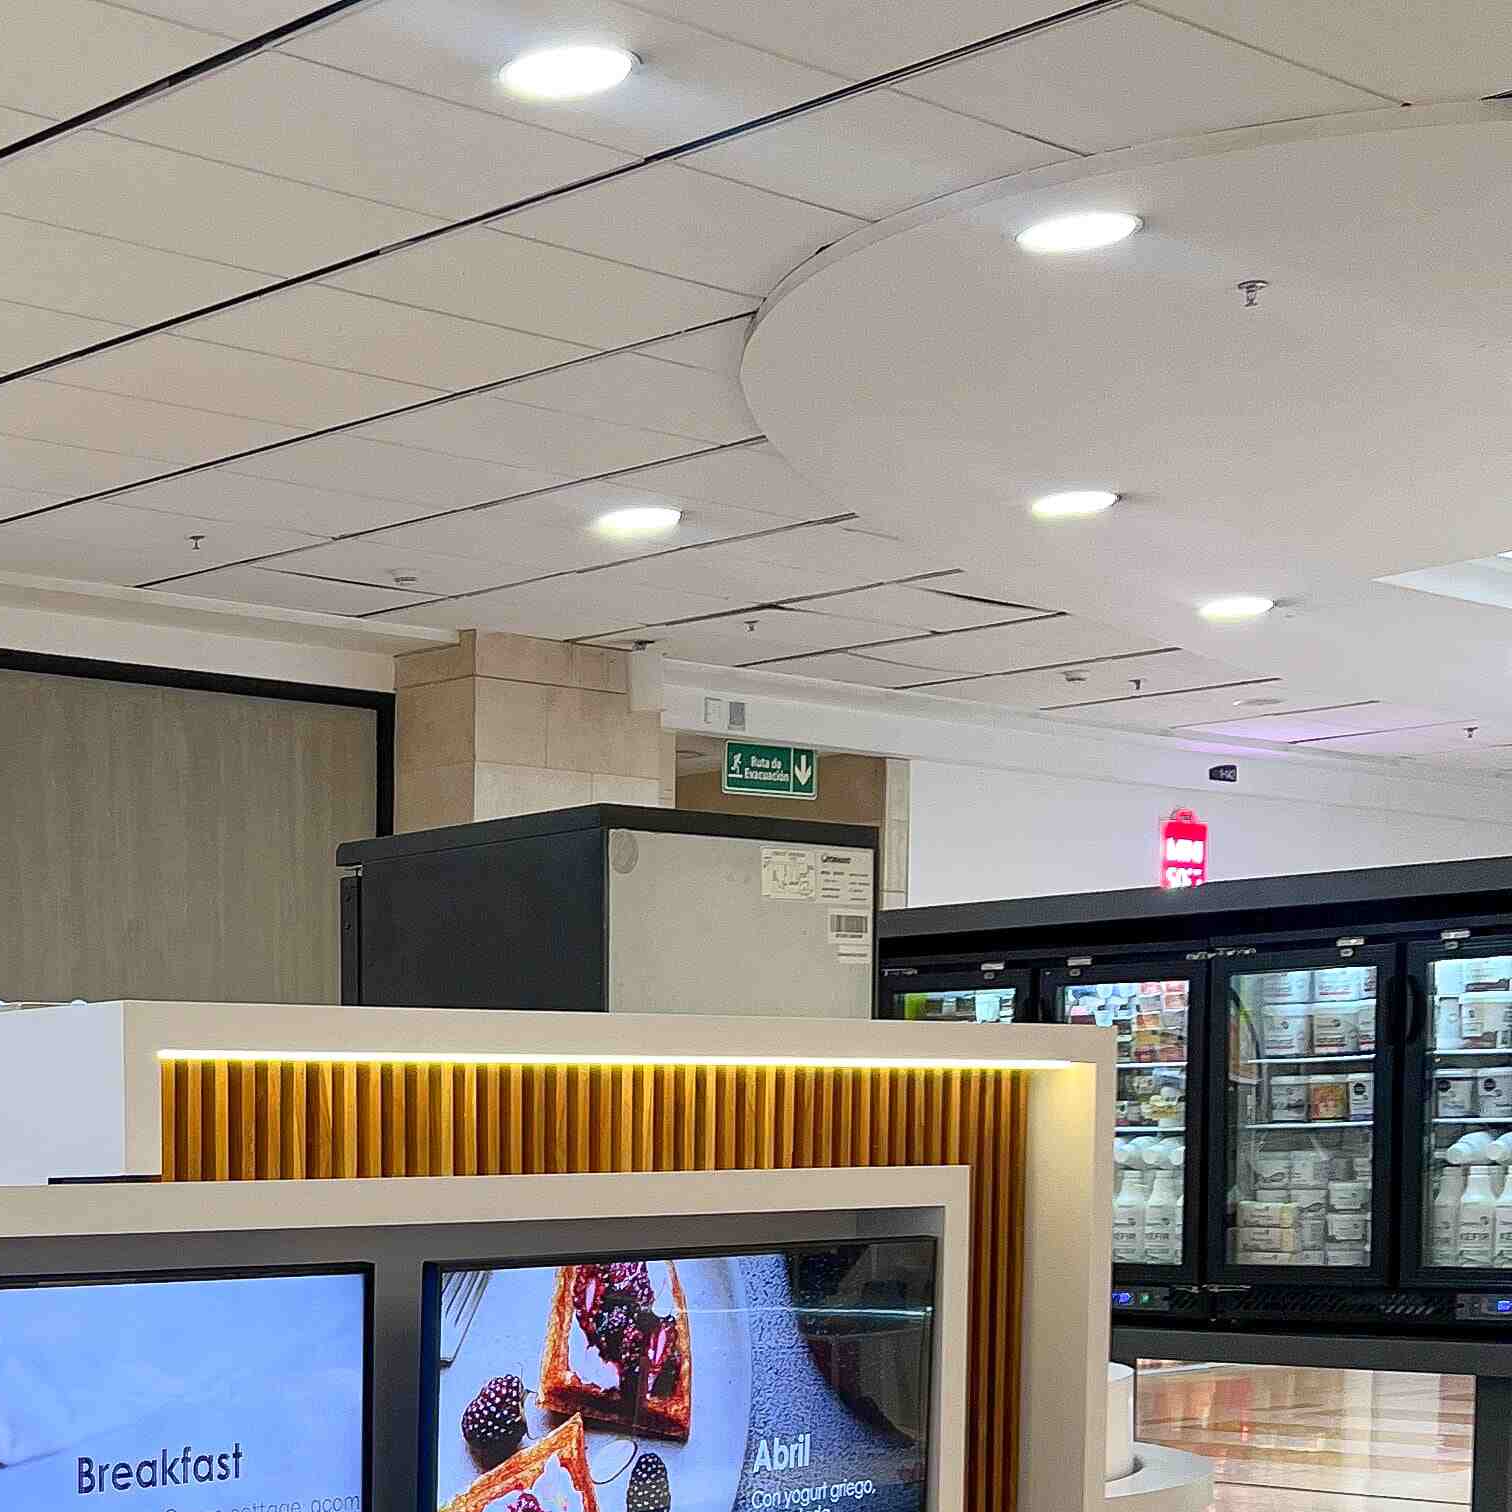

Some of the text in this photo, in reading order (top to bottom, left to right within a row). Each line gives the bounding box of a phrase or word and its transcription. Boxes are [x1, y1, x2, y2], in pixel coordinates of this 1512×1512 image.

[744, 767, 790, 781] Evacuación
[751, 756, 782, 769] Ruta de
[77, 1443, 243, 1494] Breakfast
[752, 1433, 811, 1473] Abril
[751, 1478, 876, 1509] Con yogurt griego,
